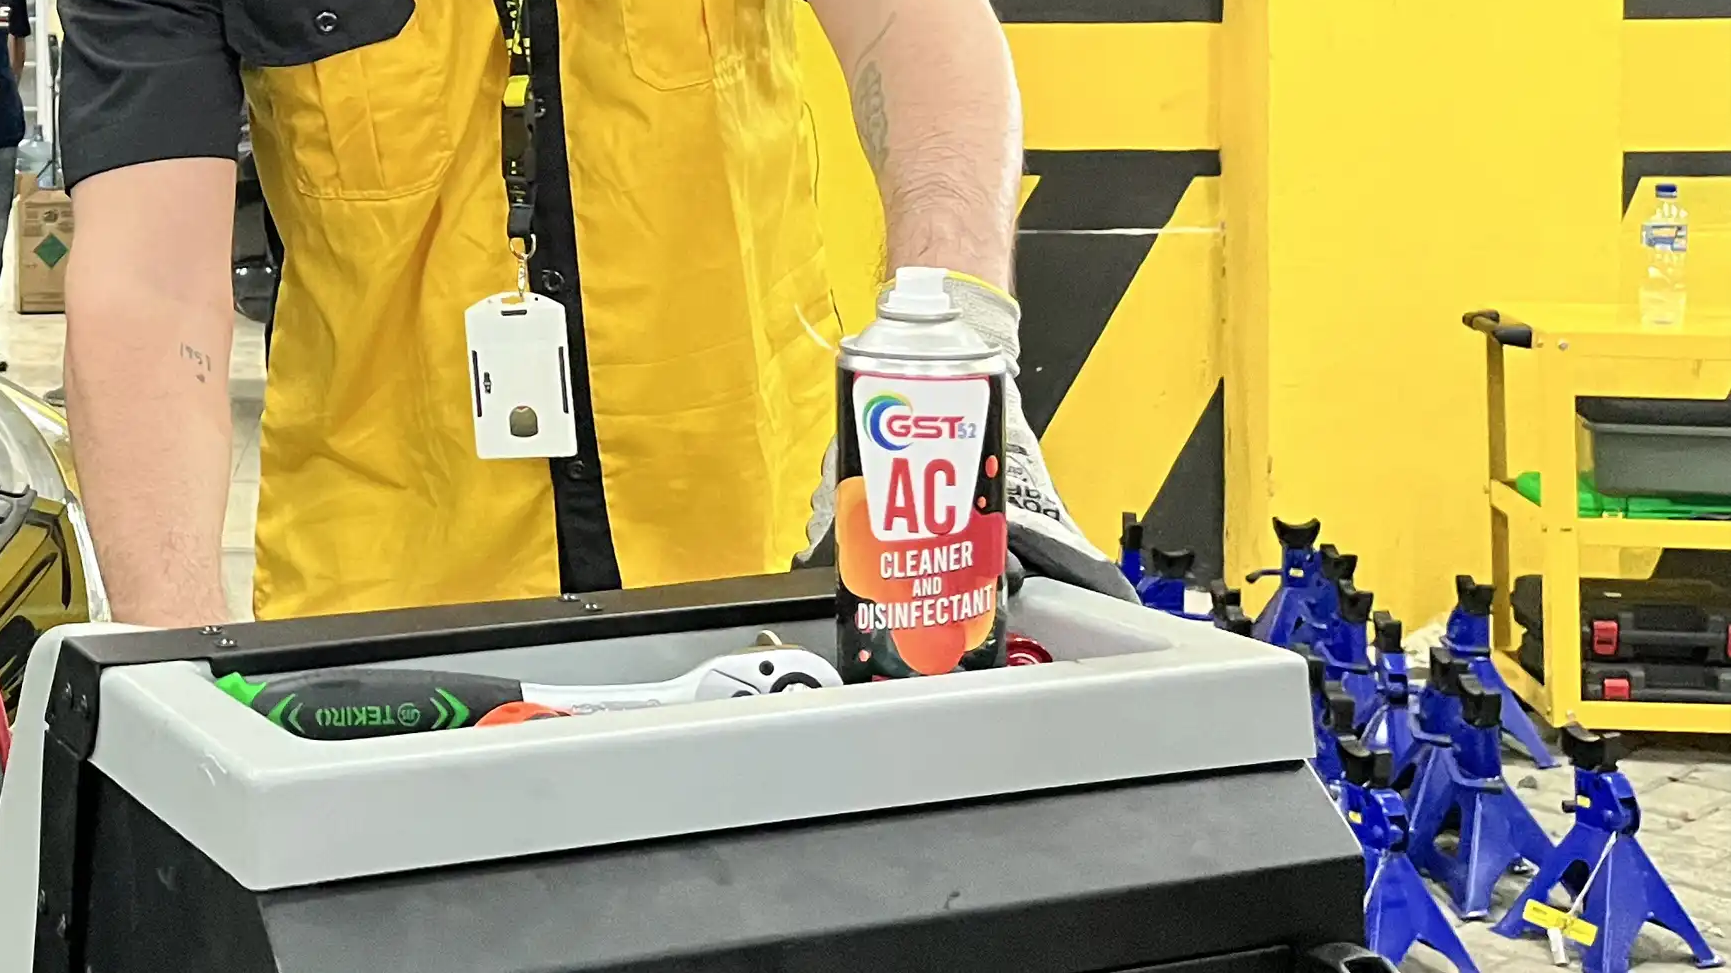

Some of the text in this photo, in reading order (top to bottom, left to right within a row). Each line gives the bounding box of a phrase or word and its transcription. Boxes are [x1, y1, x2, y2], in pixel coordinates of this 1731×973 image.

[886, 414, 965, 440] GST
[882, 457, 957, 535] AC
[880, 541, 974, 580] CLEANER
[912, 576, 943, 597] AND
[856, 584, 994, 630] DISINFECTANT
[315, 705, 396, 727] TEKIRO
